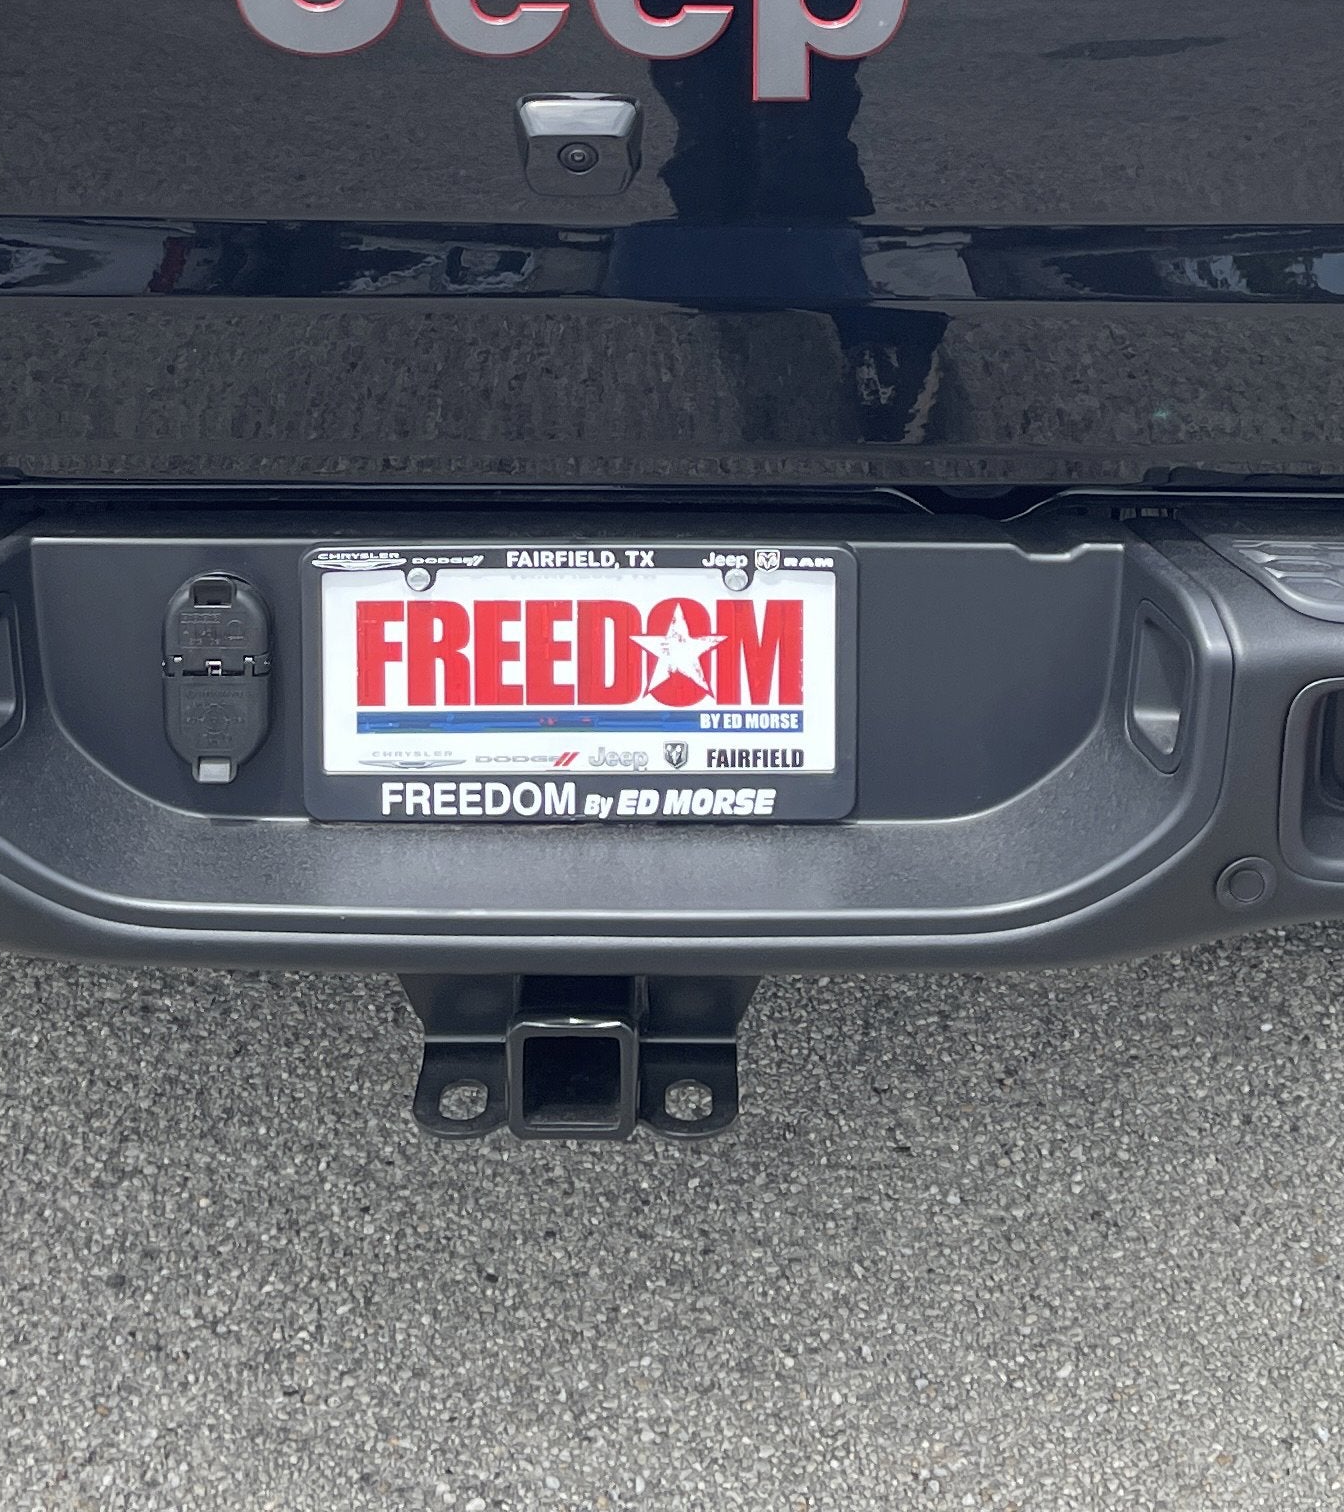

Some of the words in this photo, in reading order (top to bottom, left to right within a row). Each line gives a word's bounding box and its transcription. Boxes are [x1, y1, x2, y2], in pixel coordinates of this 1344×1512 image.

[317, 552, 400, 560] CHRYSLER
[505, 550, 620, 569] FAIRFIELD,
[624, 550, 655, 568] TX
[701, 551, 749, 569] Jeep
[783, 557, 834, 568] RAM
[356, 597, 804, 707] FREEDOM
[699, 713, 720, 729] BY
[723, 713, 742, 729] ED
[745, 713, 799, 729] MORSE
[587, 746, 650, 771] Jeep
[706, 748, 805, 768] FAIRFIELD
[380, 781, 577, 816] FREEDOM
[583, 793, 614, 819] By
[615, 788, 660, 816] ED
[662, 788, 777, 816] MORSE
